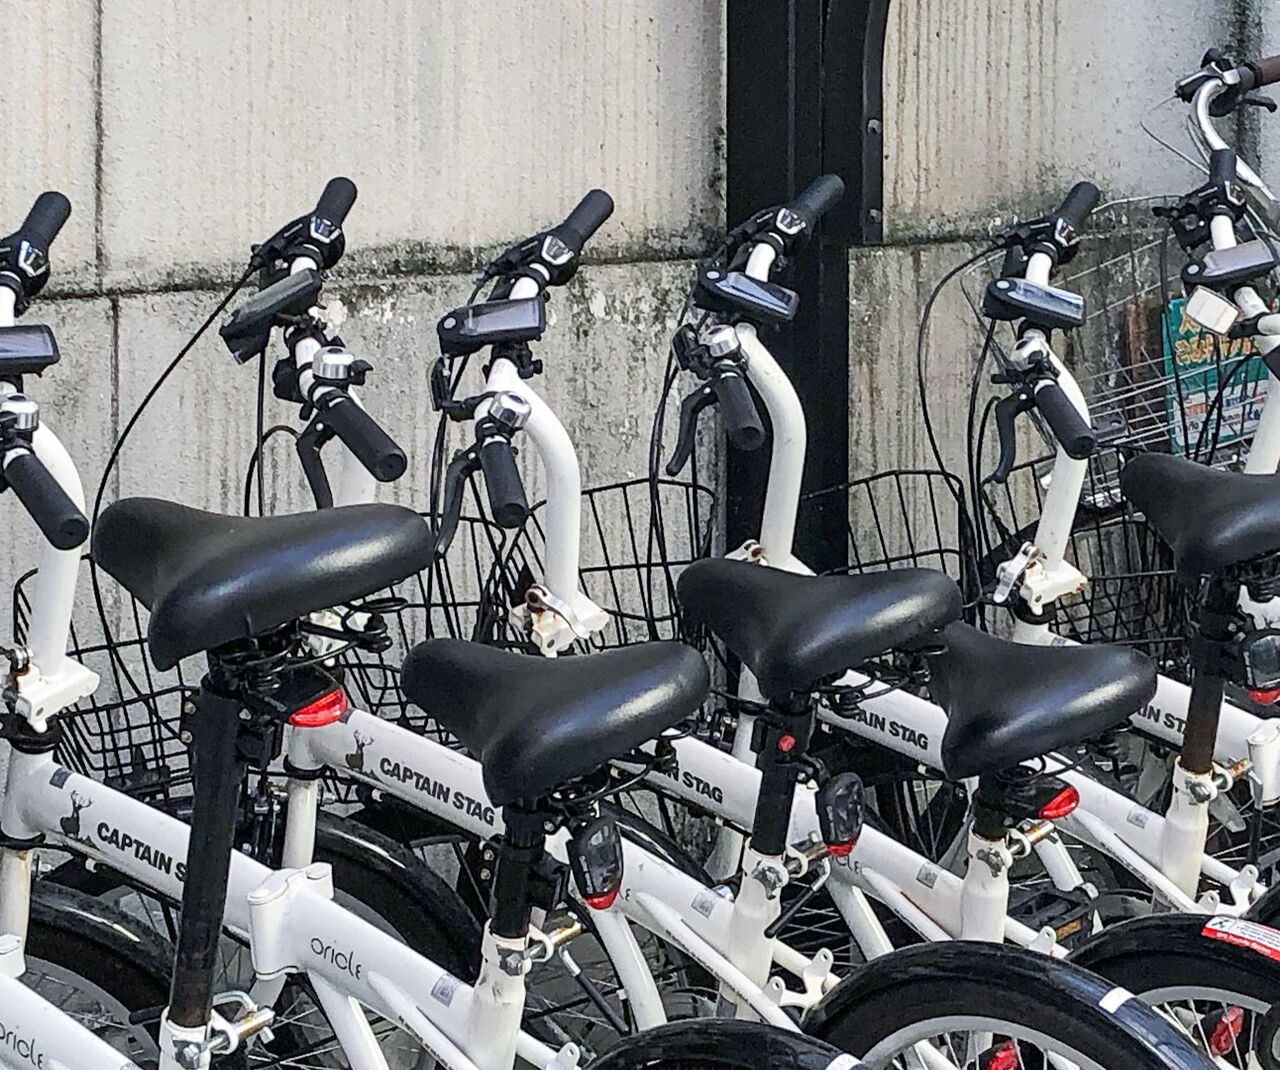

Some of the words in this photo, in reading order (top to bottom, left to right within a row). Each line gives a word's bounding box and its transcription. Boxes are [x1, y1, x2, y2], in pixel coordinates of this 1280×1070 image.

[888, 720, 929, 751] STAG
[379, 757, 451, 804] CAPTAIN
[452, 791, 495, 827] STAG
[682, 771, 723, 804] STAG
[97, 821, 173, 875] CAPTAIN
